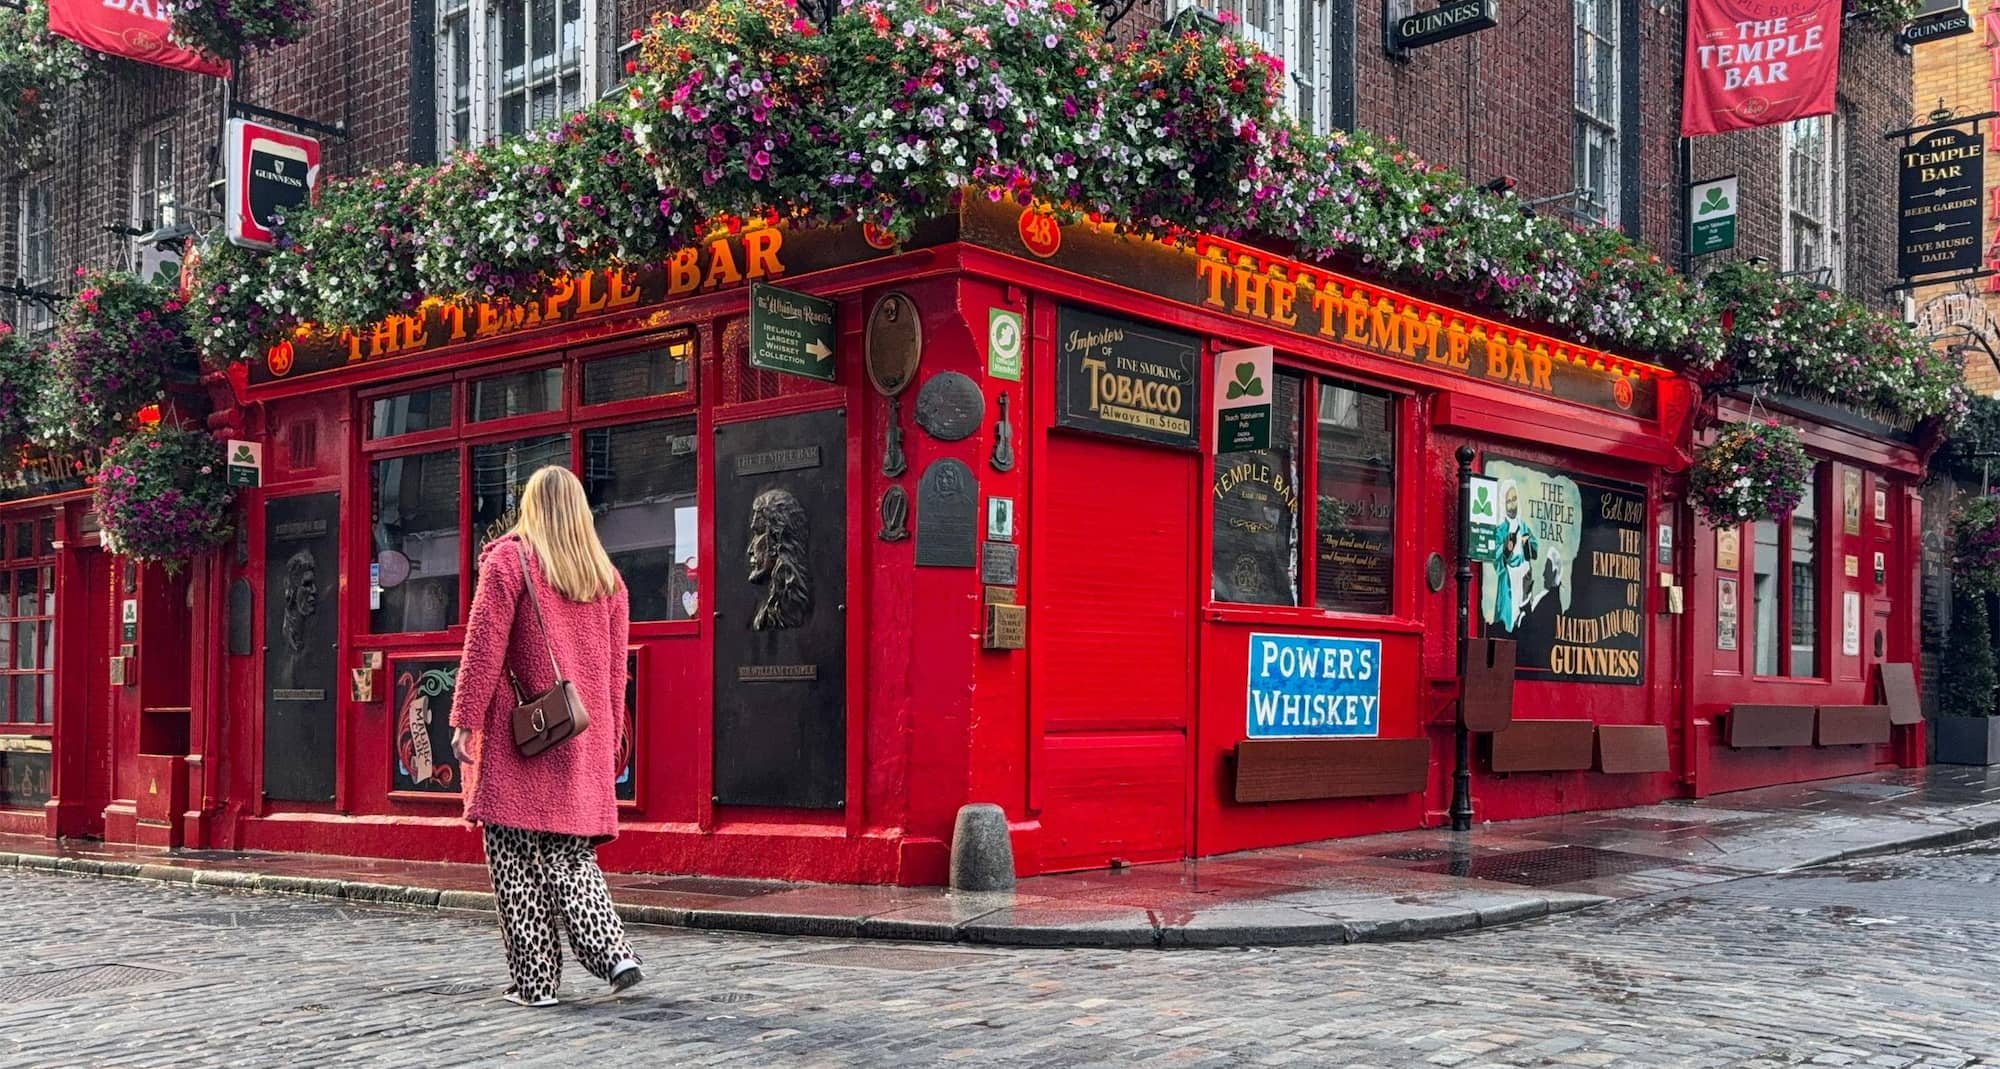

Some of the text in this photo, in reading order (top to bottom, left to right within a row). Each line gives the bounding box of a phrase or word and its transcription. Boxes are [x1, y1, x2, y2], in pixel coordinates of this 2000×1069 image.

[1402, 2, 1480, 37] GUINNESS
[1736, 17, 1788, 40] THE
[1908, 17, 1967, 39] GUINNESS
[1697, 25, 1824, 69] TEMPLE
[1724, 61, 1789, 91] BAR
[1929, 136, 1956, 148] THE
[1904, 145, 1981, 168] TEMPLE
[255, 169, 302, 187] GUINNESS
[1921, 165, 1963, 183] BAR
[1904, 198, 1977, 217] BEER GARDEN
[1027, 217, 1052, 245] 48
[1907, 236, 1974, 253] LIVE MUSIC
[1922, 251, 1957, 263] DAILY
[668, 227, 785, 297] BAR
[763, 323, 802, 338] IRELAND'S
[1200, 258, 1553, 392] THE TEMPLE BAR
[765, 341, 800, 355] WHISKEY
[766, 333, 799, 346] LARGEST
[1065, 327, 1124, 357] Importers
[1102, 346, 1113, 357] OF
[759, 349, 805, 365] COLLECTION
[1117, 356, 1181, 381] FINE SMOKING
[1081, 356, 1182, 414] TOBACCO
[1102, 406, 1189, 432] Always in Stock
[1213, 463, 1270, 501] TEMPLE
[1540, 481, 1564, 503] THE
[1528, 499, 1574, 526] TEMPLE
[1540, 522, 1564, 544] BAR
[1619, 528, 1641, 555] THE
[1592, 551, 1641, 582] EMPEROR
[1627, 582, 1640, 607] OF
[1556, 609, 1641, 644] MALTED LIQUORS
[1260, 641, 1372, 680] POWER'S
[1551, 645, 1639, 677] GUINNESS
[1251, 690, 1376, 726] WHISKEY
[411, 721, 424, 760] CASK
[415, 707, 431, 767] MALBEC
